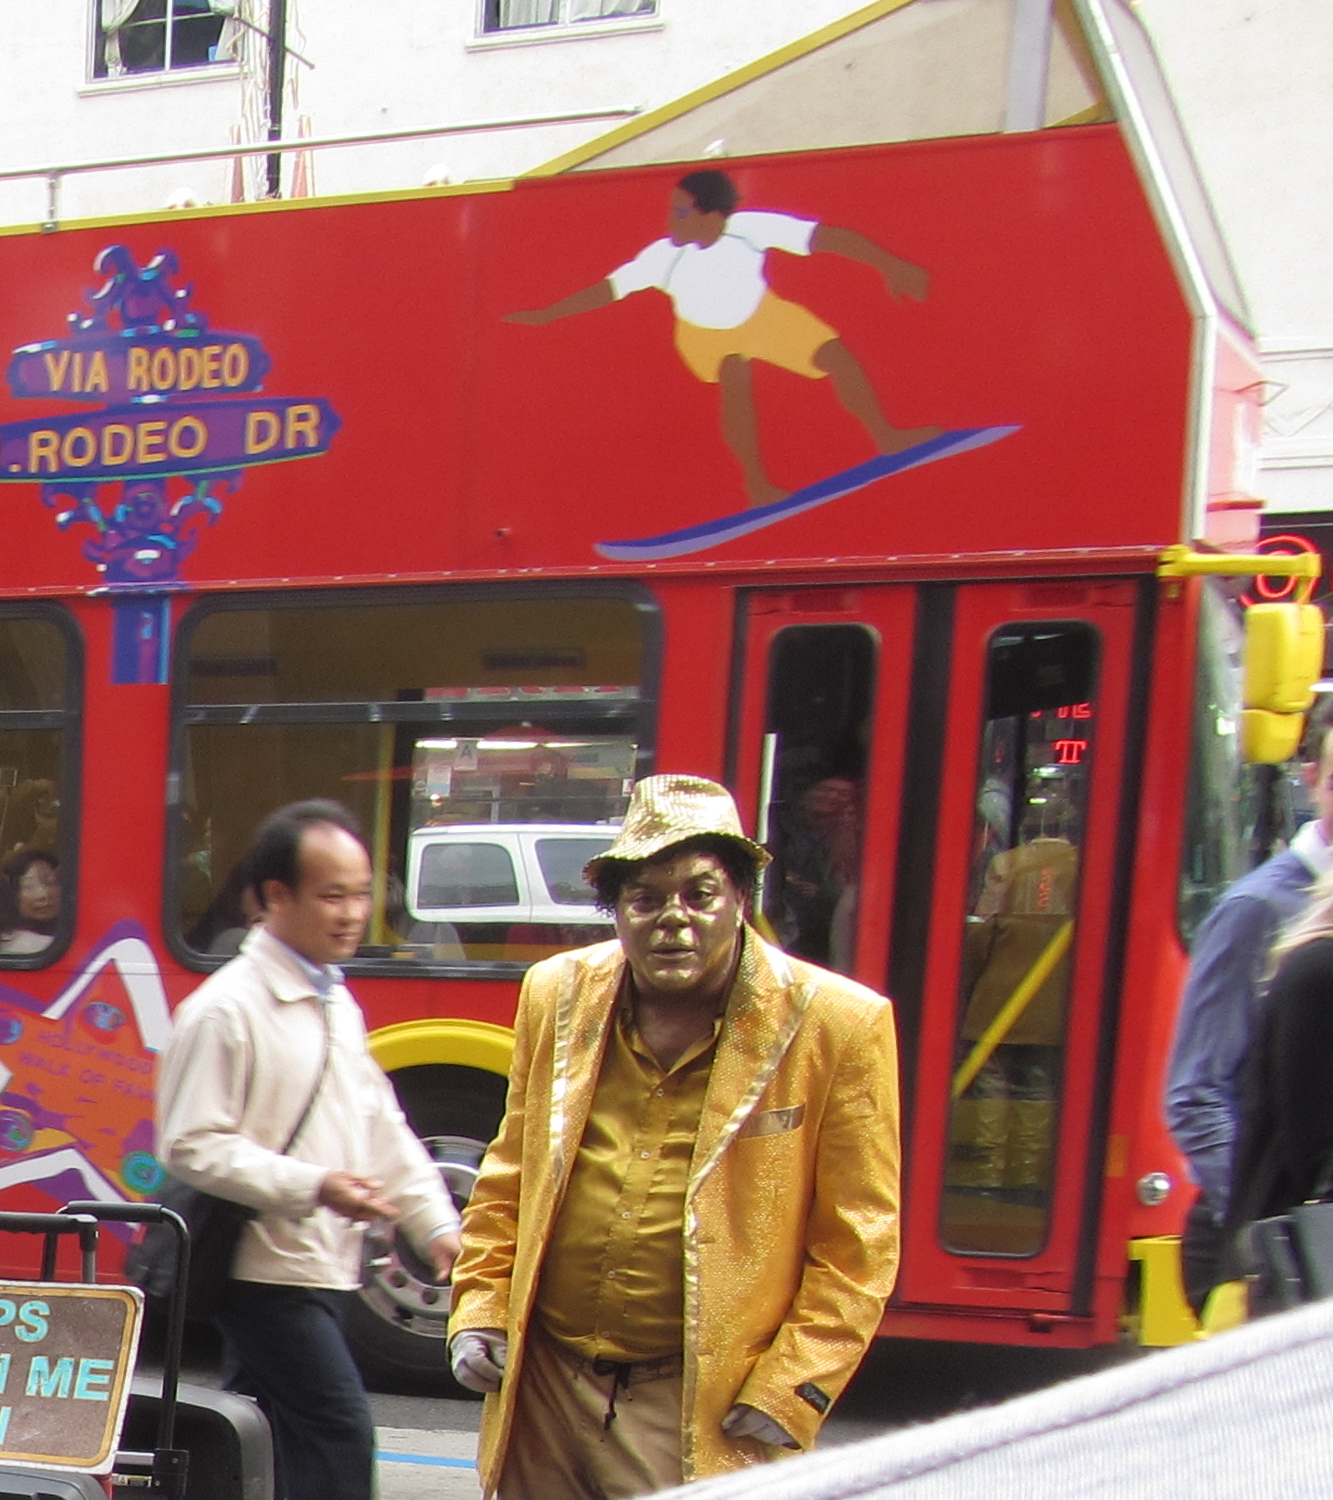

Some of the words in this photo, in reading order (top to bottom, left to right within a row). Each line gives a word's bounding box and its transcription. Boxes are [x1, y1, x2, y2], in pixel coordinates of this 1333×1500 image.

[45, 353, 109, 393] VIA
[127, 344, 250, 391] RODEO
[244, 405, 322, 455] DR
[78, 1069, 106, 1085] OF
[26, 1358, 118, 1403] ME
